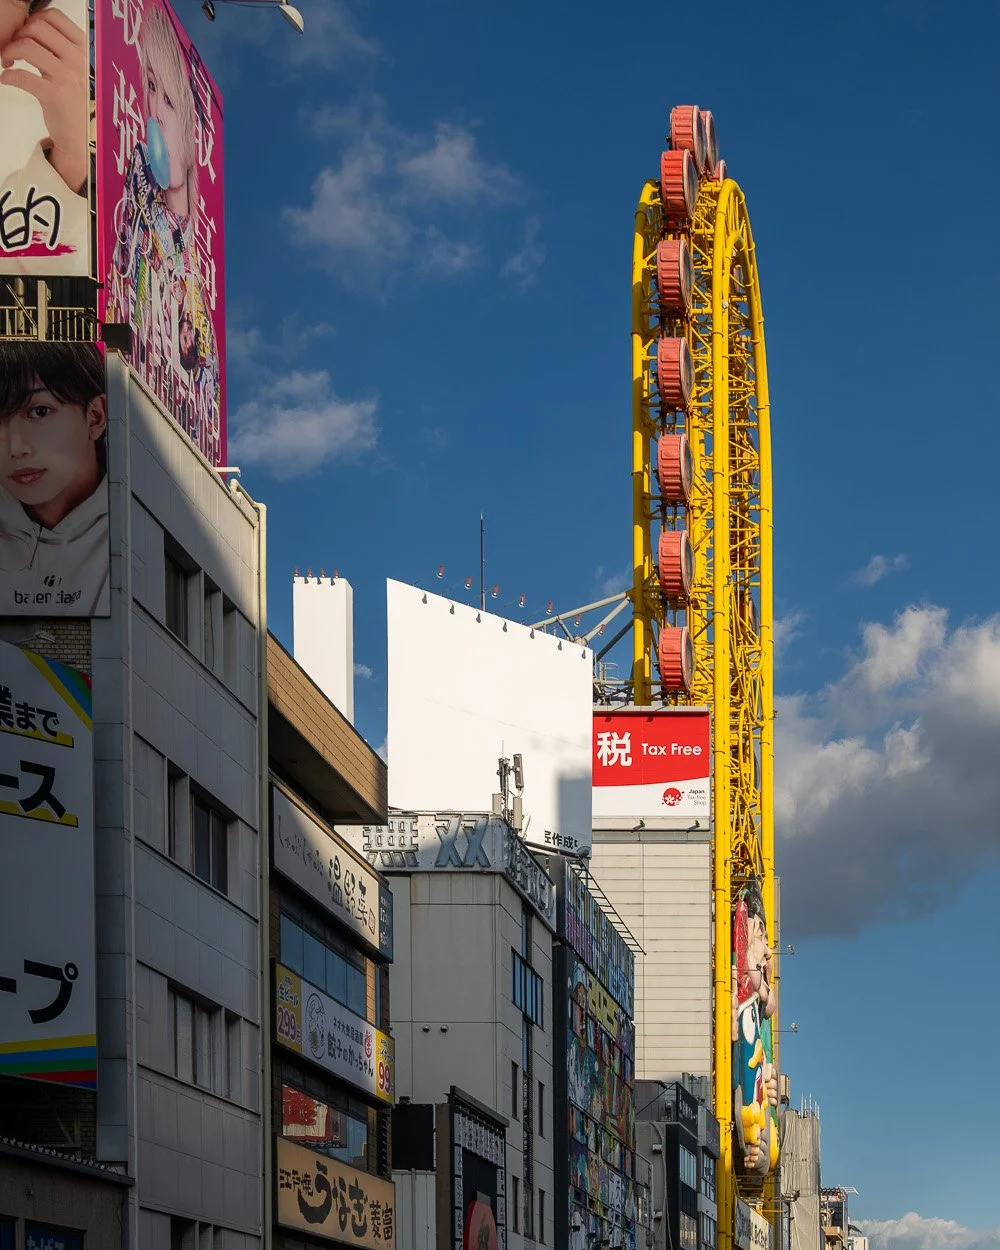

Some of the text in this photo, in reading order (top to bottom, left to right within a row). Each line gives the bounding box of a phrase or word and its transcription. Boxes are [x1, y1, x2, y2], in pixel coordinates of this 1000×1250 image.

[597, 732, 633, 767] 税
[641, 743, 703, 756] Tax Free
[688, 788, 705, 796] Japan
[297, 1160, 369, 1238] うなぎ
